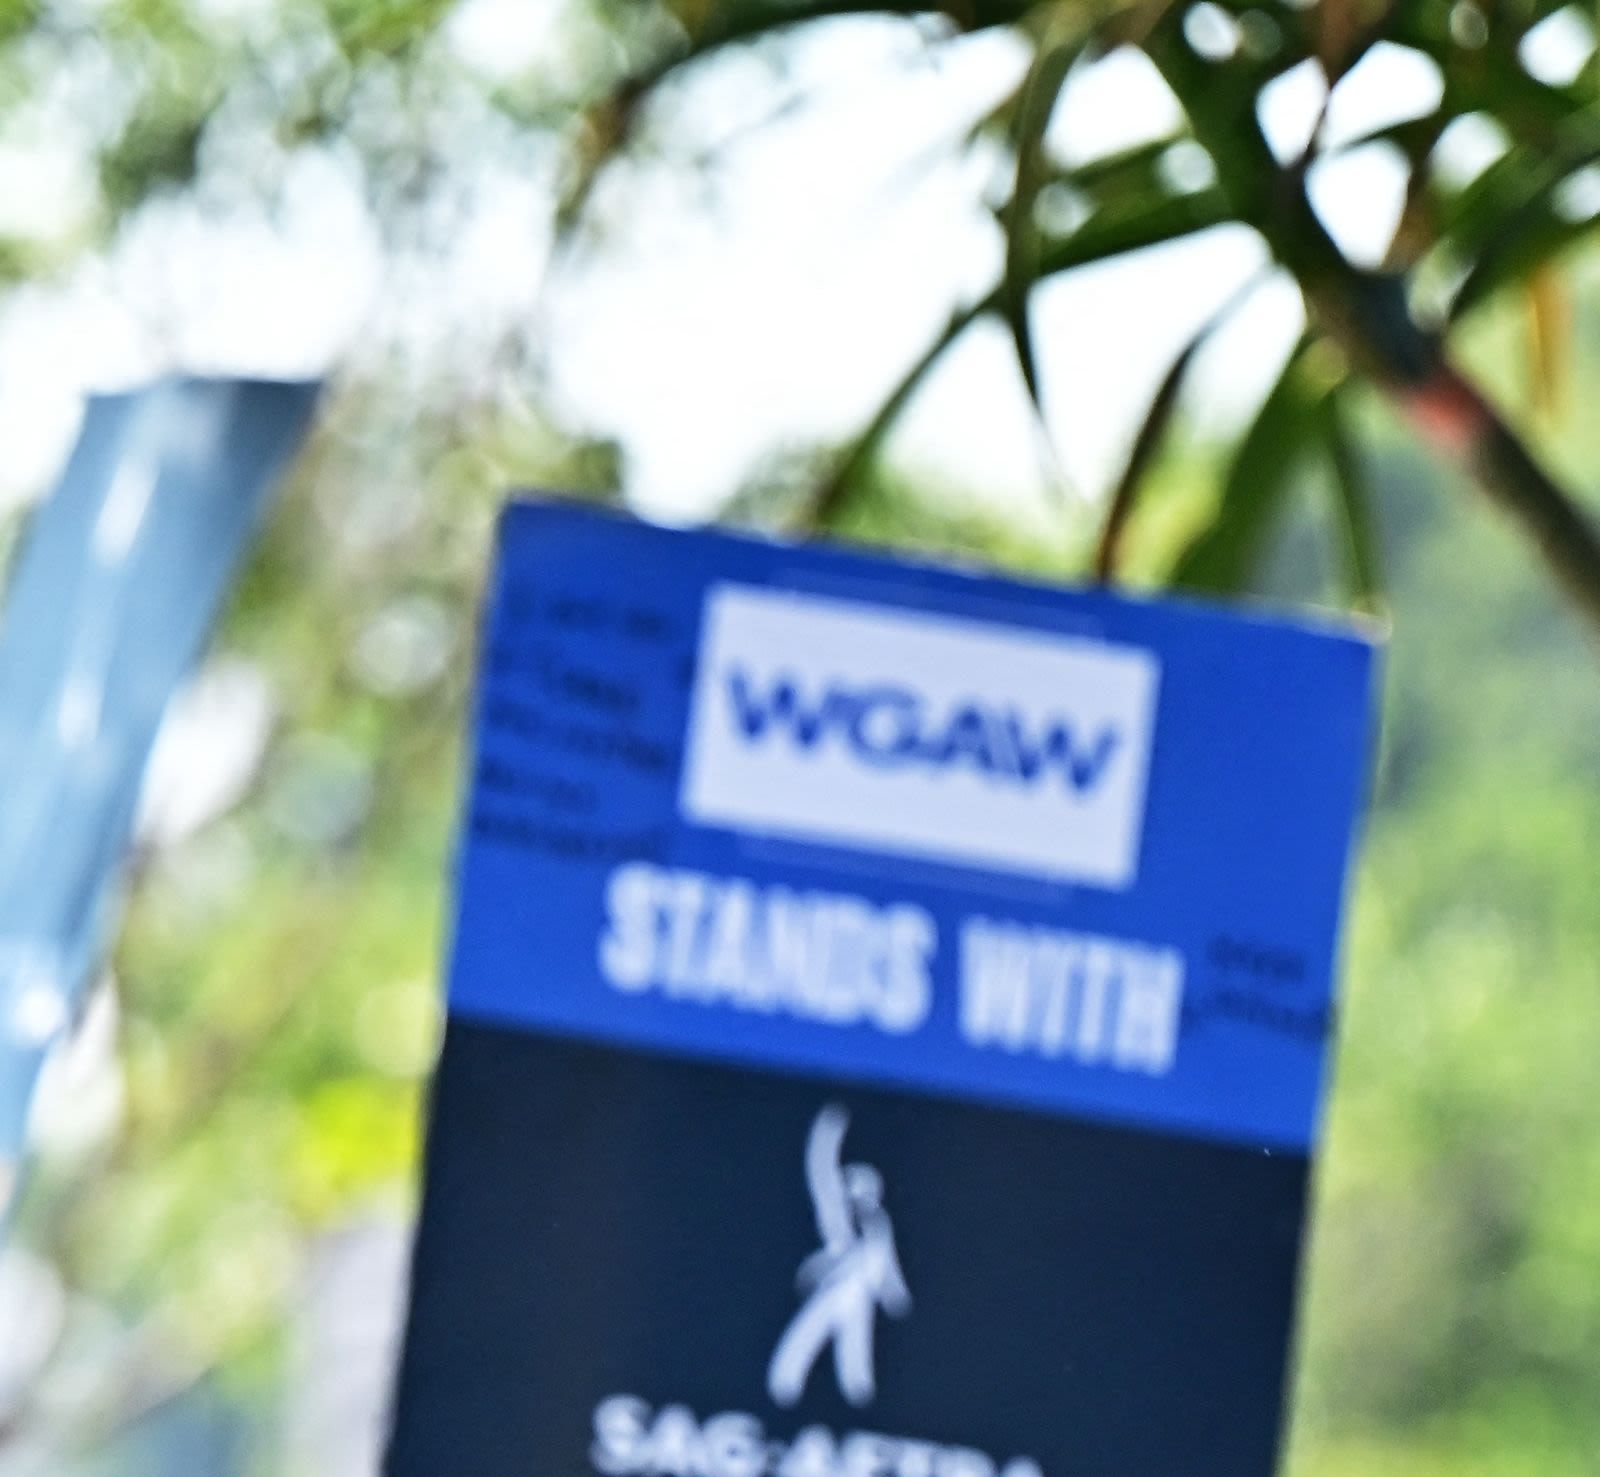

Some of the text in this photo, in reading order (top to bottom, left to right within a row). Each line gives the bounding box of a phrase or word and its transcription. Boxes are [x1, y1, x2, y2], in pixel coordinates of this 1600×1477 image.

[723, 660, 1123, 798] WGAW
[601, 862, 932, 1033] STANDS
[958, 917, 1183, 1076] WITH
